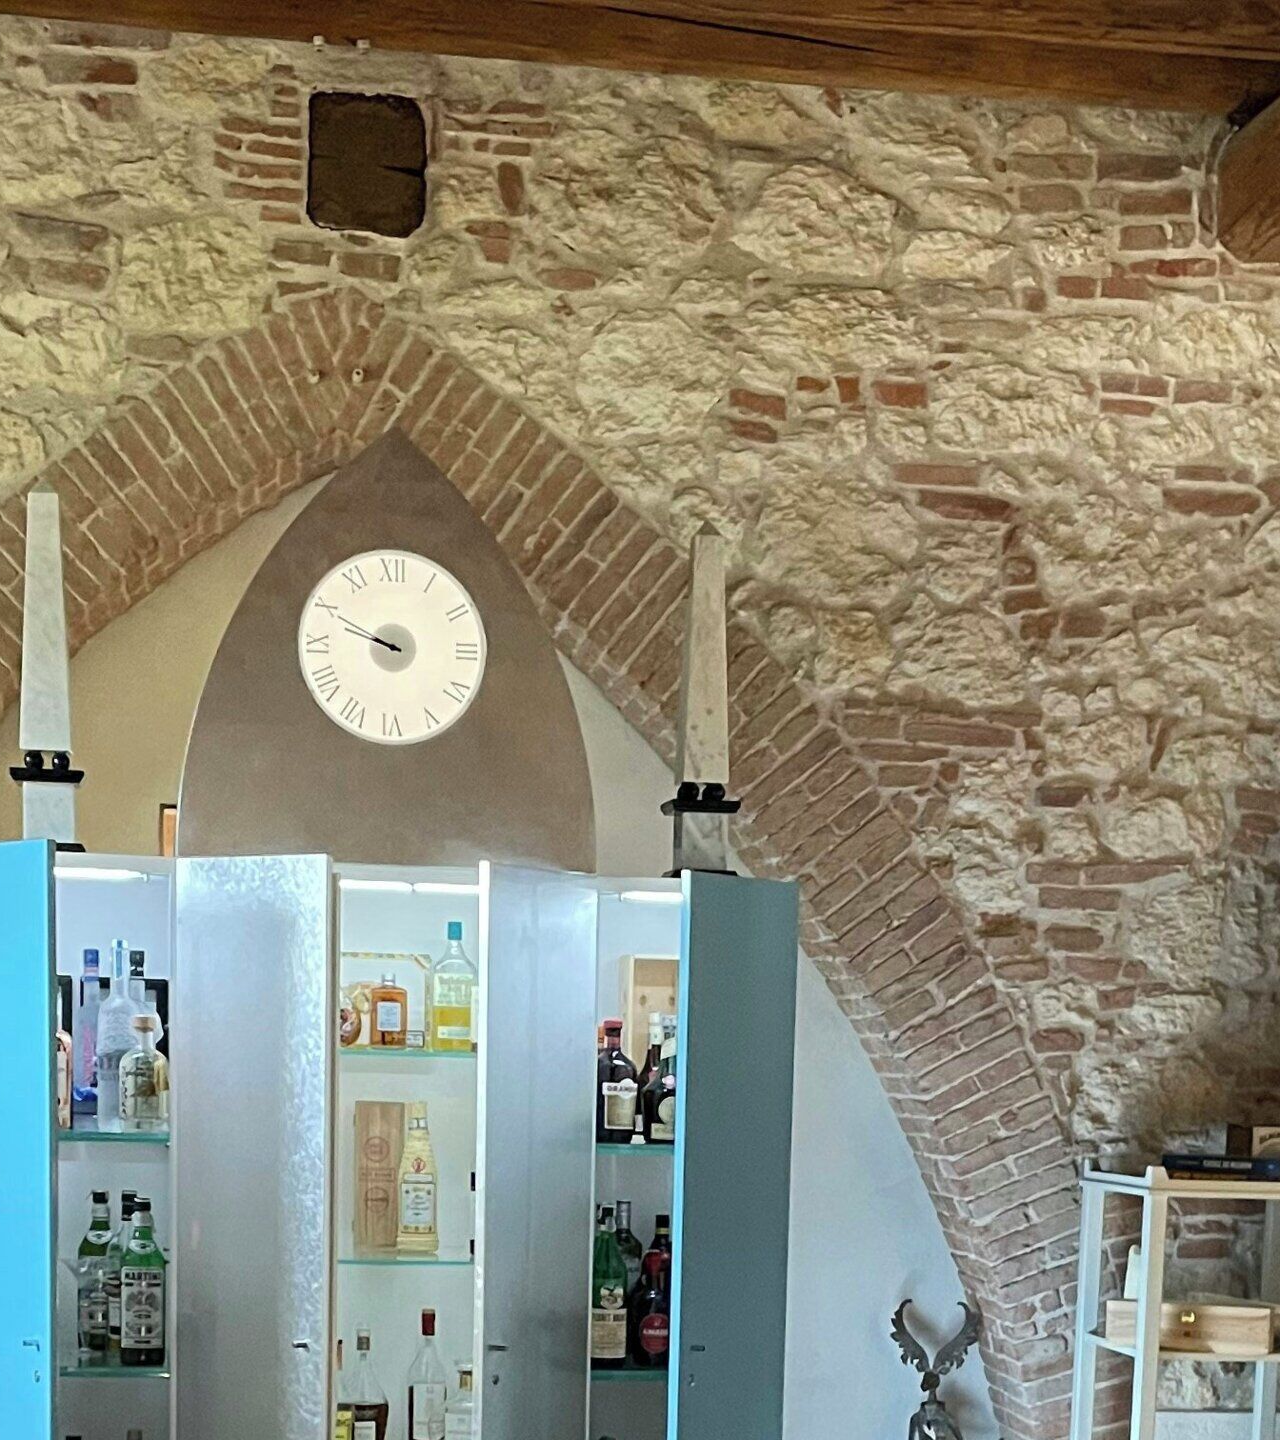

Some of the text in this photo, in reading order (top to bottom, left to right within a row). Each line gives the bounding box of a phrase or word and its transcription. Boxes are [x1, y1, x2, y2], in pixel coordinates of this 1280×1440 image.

[341, 565, 368, 594] XI
[379, 558, 406, 583] XII
[423, 573, 437, 594] I
[314, 596, 338, 618] X
[445, 603, 469, 622] II
[306, 633, 330, 654] IX
[455, 642, 478, 661] III
[311, 664, 341, 702] VIII
[339, 696, 366, 729] VII
[423, 707, 441, 730] V
[382, 712, 403, 737] VI
